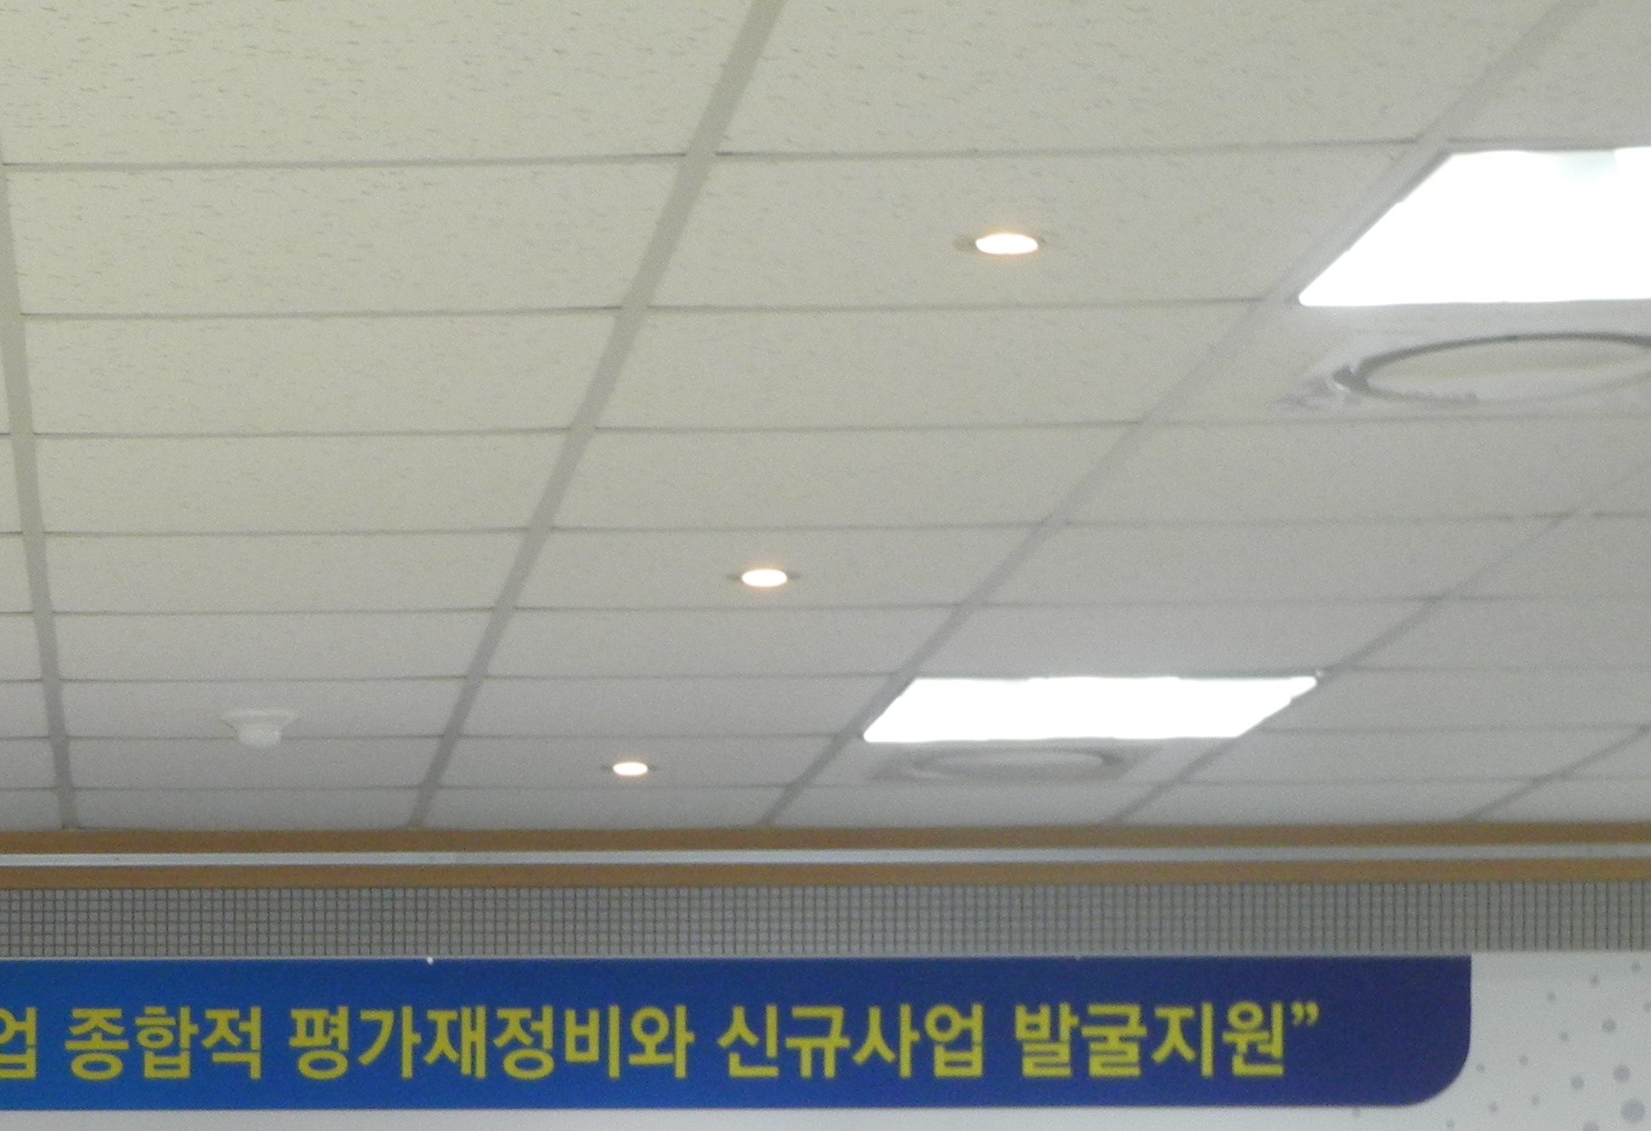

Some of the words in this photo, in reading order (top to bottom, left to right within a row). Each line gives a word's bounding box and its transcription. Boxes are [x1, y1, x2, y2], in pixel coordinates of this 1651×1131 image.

[64, 1005, 263, 1082] 종합적
[288, 1004, 695, 1081] 평가재정비와
[716, 1003, 985, 1080] 신규사업
[1013, 1000, 1320, 1079] 발굴지원”
